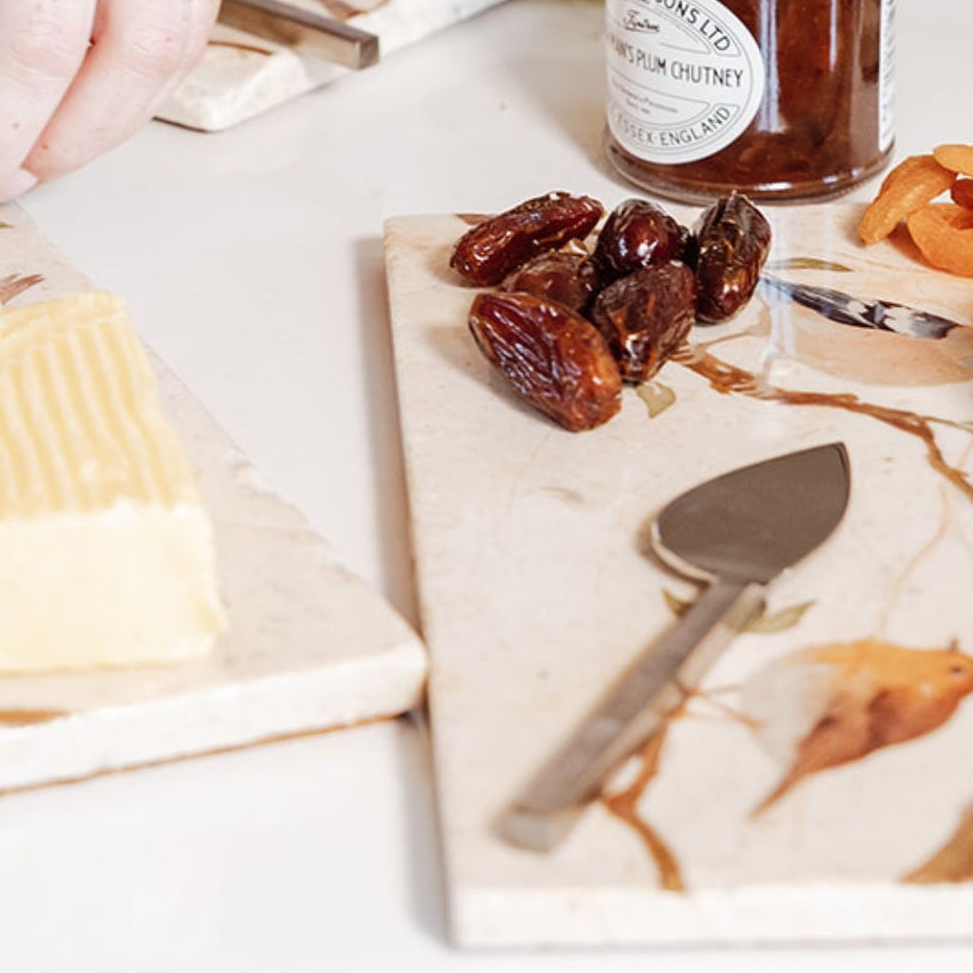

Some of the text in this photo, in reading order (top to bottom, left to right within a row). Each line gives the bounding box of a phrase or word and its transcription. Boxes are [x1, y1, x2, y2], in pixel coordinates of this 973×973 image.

[699, 18, 731, 52] LTD
[636, 48, 667, 76] PLUM
[670, 60, 744, 88] CHUTNEY
[660, 107, 731, 146] ENGLAND
